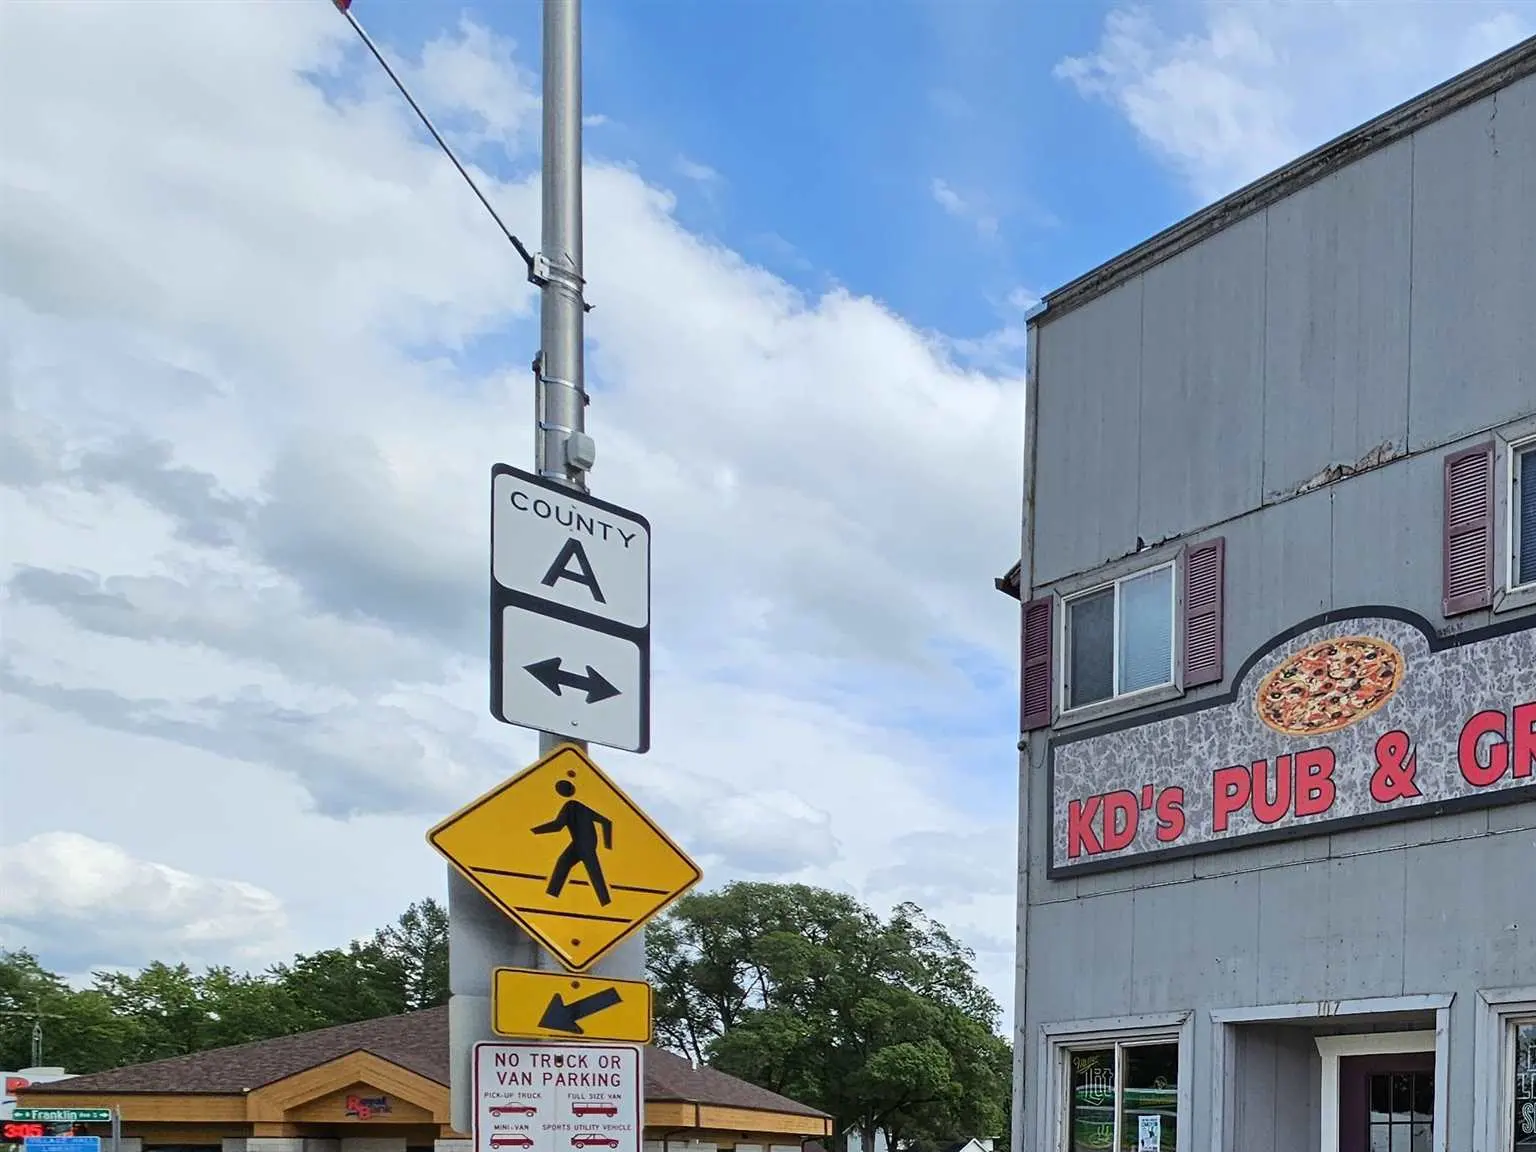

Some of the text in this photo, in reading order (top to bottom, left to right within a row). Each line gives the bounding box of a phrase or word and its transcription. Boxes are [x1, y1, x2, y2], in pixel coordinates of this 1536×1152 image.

[510, 491, 636, 548] COUNTY
[541, 537, 607, 605] A
[1212, 746, 1337, 832] PUB
[1369, 729, 1420, 803] &
[495, 1053, 621, 1069] NO TRUCK OR
[496, 1071, 621, 1087] VAN PARKING
[31, 1110, 78, 1120] Franklin
